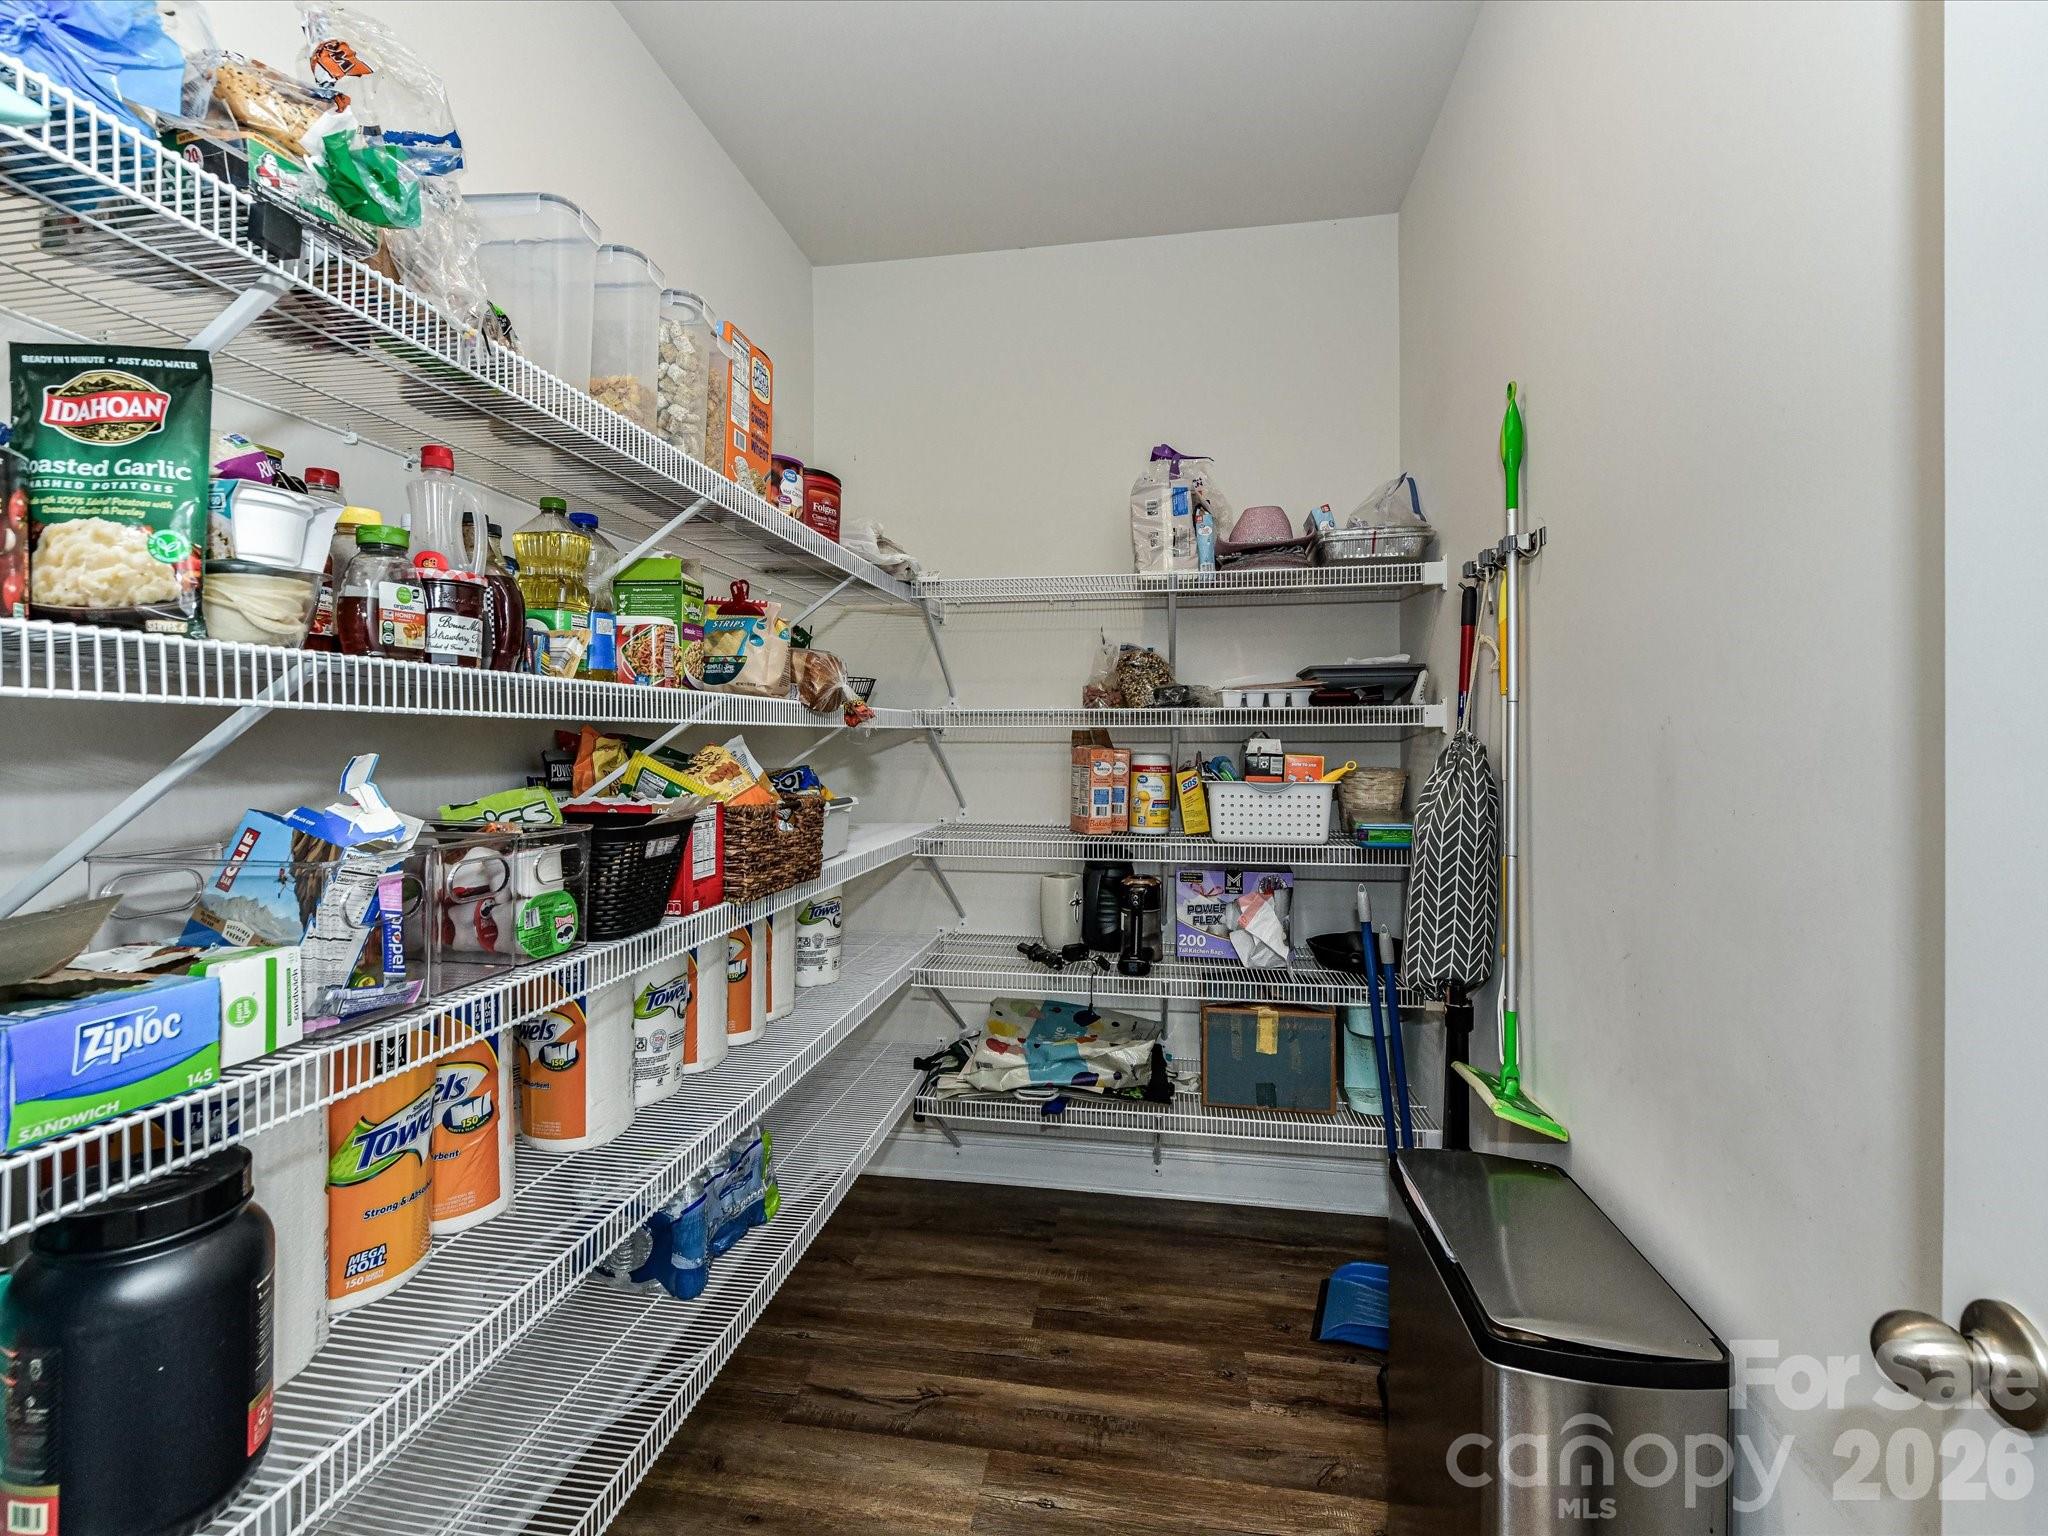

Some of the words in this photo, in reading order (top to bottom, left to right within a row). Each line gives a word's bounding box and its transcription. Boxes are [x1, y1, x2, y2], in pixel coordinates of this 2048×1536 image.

[184, 147, 200, 163] 20
[21, 355, 52, 364] READY
[70, 355, 105, 364] MINUTE
[116, 357, 141, 366] JUST
[142, 358, 163, 368] ADD
[163, 360, 198, 370] WATER
[49, 396, 162, 423] IDAHOAN
[114, 458, 192, 480] Garlic
[92, 482, 174, 494] POTATOES
[812, 501, 837, 517] Folgers
[393, 603, 415, 612] organic
[394, 612, 416, 620] HONEY
[438, 615, 467, 630] Bonne
[712, 620, 746, 628] STRIPS
[148, 622, 175, 632] SERVES
[429, 628, 470, 646] Strawberry
[551, 763, 573, 778] POWE
[226, 832, 255, 877] CLIF
[808, 901, 841, 920] Towels
[1187, 903, 1227, 916] POWER
[1192, 915, 1223, 926] FLEX
[225, 930, 247, 943] ENERGY
[226, 923, 251, 939] SUSTAINED
[385, 913, 406, 969] propel
[1178, 934, 1207, 947] 200
[292, 968, 300, 1021] sandwich
[82, 1012, 183, 1065] Ziploc
[551, 1058, 565, 1067] 150
[187, 1067, 213, 1088] 145
[17, 1100, 121, 1145] SANDWICH
[460, 1115, 479, 1128] 150
[352, 1107, 434, 1173] Towe
[363, 1202, 399, 1220] Strong
[399, 1196, 408, 1206] &
[348, 1245, 387, 1266] MEGA
[346, 1255, 387, 1279] ROLL
[344, 1276, 364, 1290] 150
